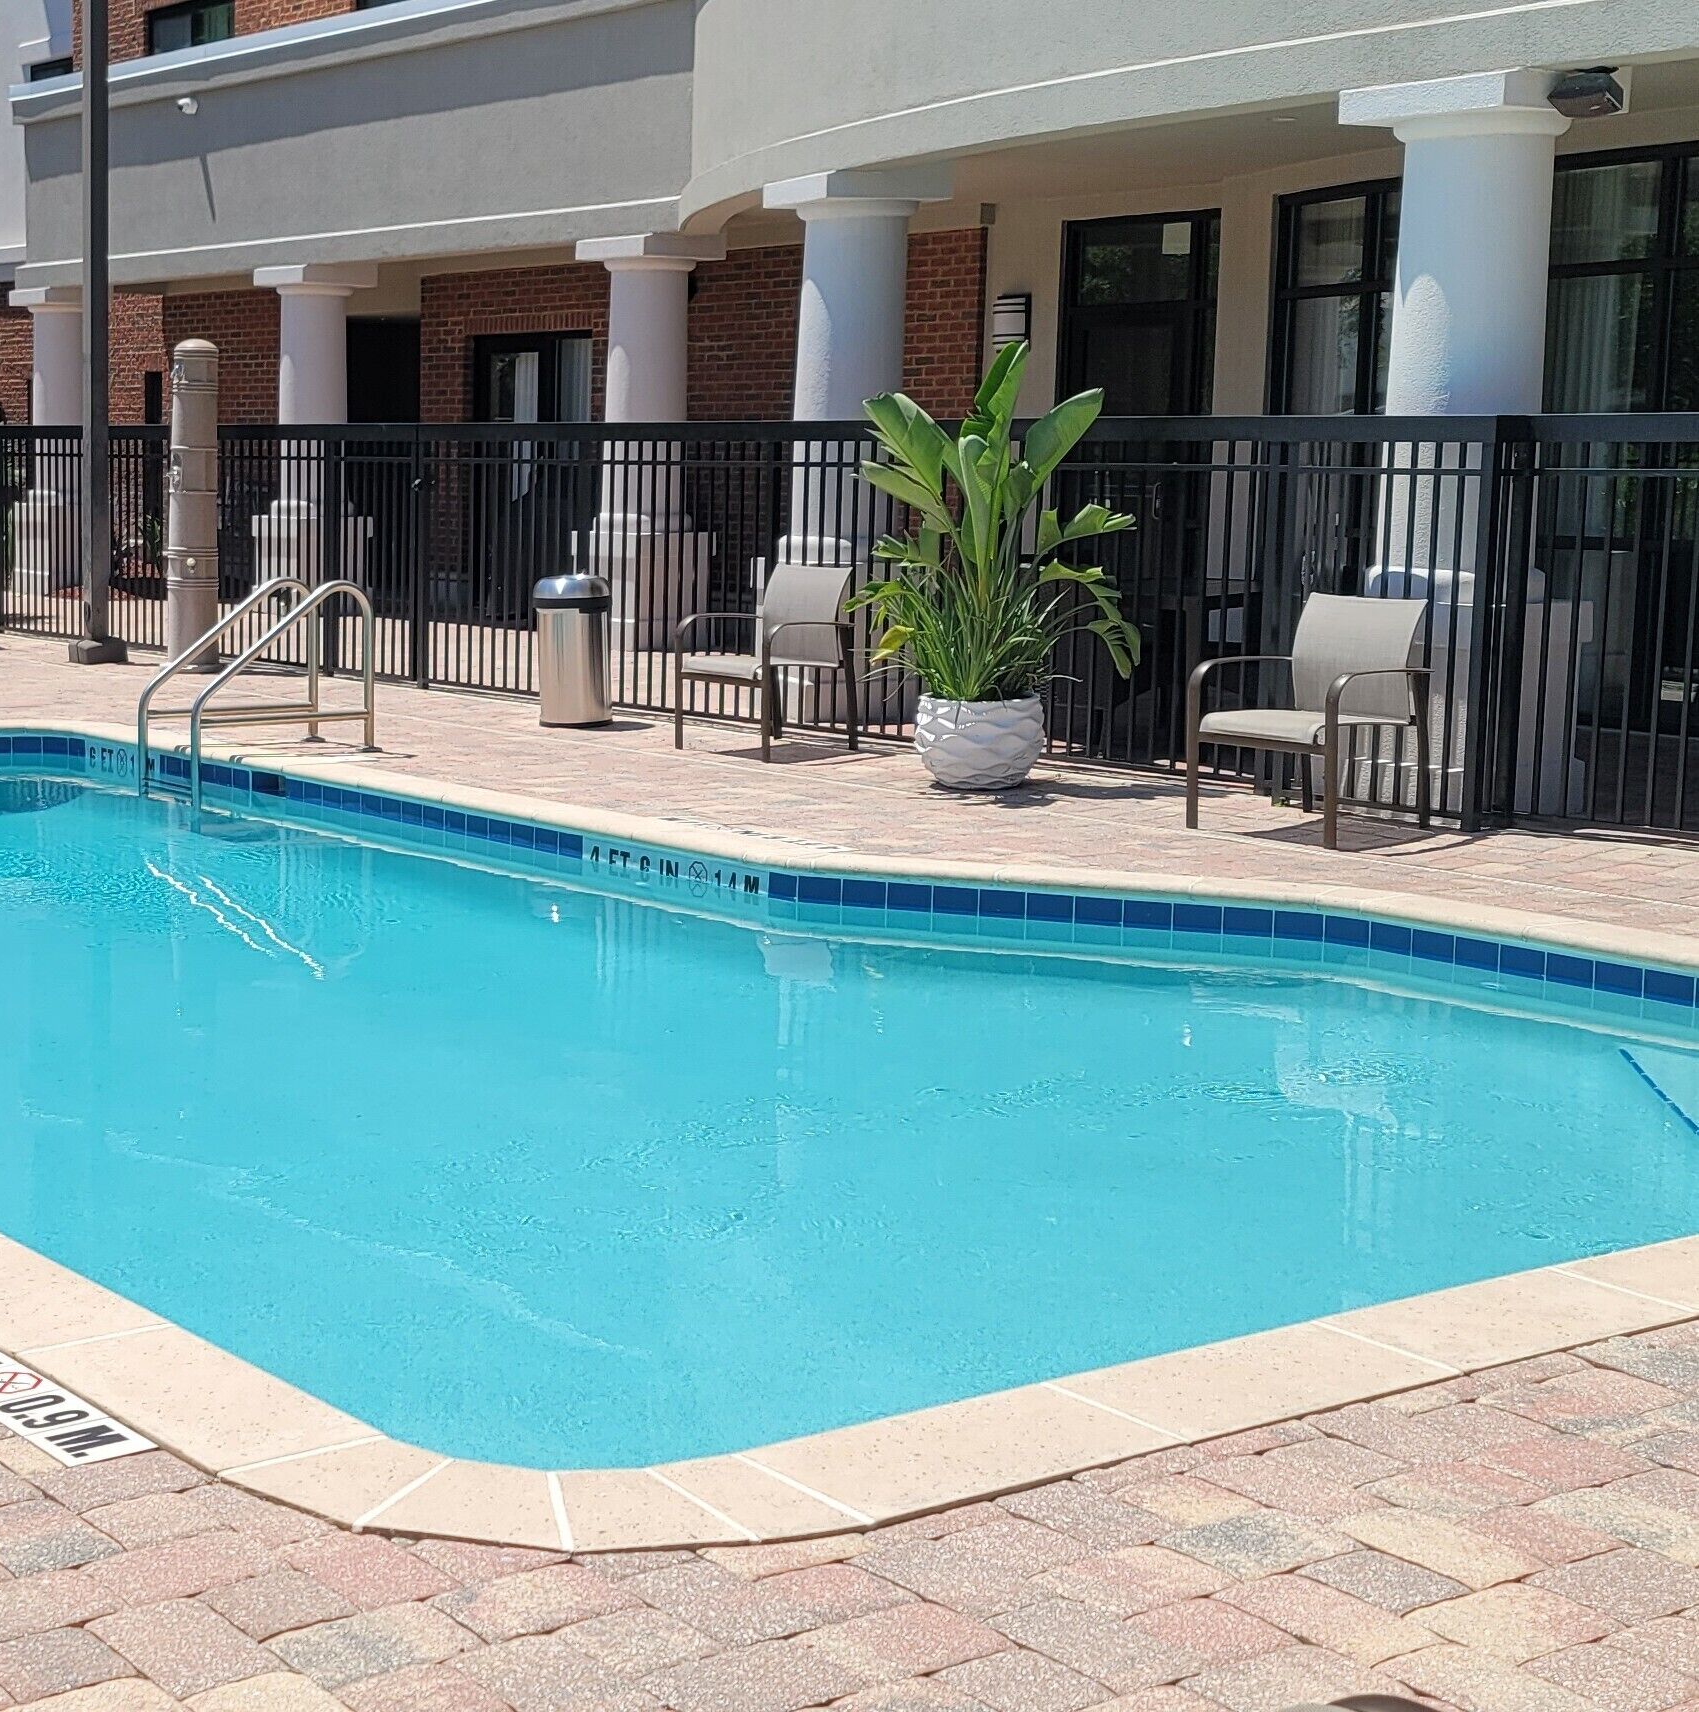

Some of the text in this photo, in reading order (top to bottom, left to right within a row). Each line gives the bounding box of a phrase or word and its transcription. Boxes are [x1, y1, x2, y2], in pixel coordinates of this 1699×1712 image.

[609, 848, 631, 868] FT
[659, 858, 679, 879] IN
[44, 1423, 131, 1459] M.
